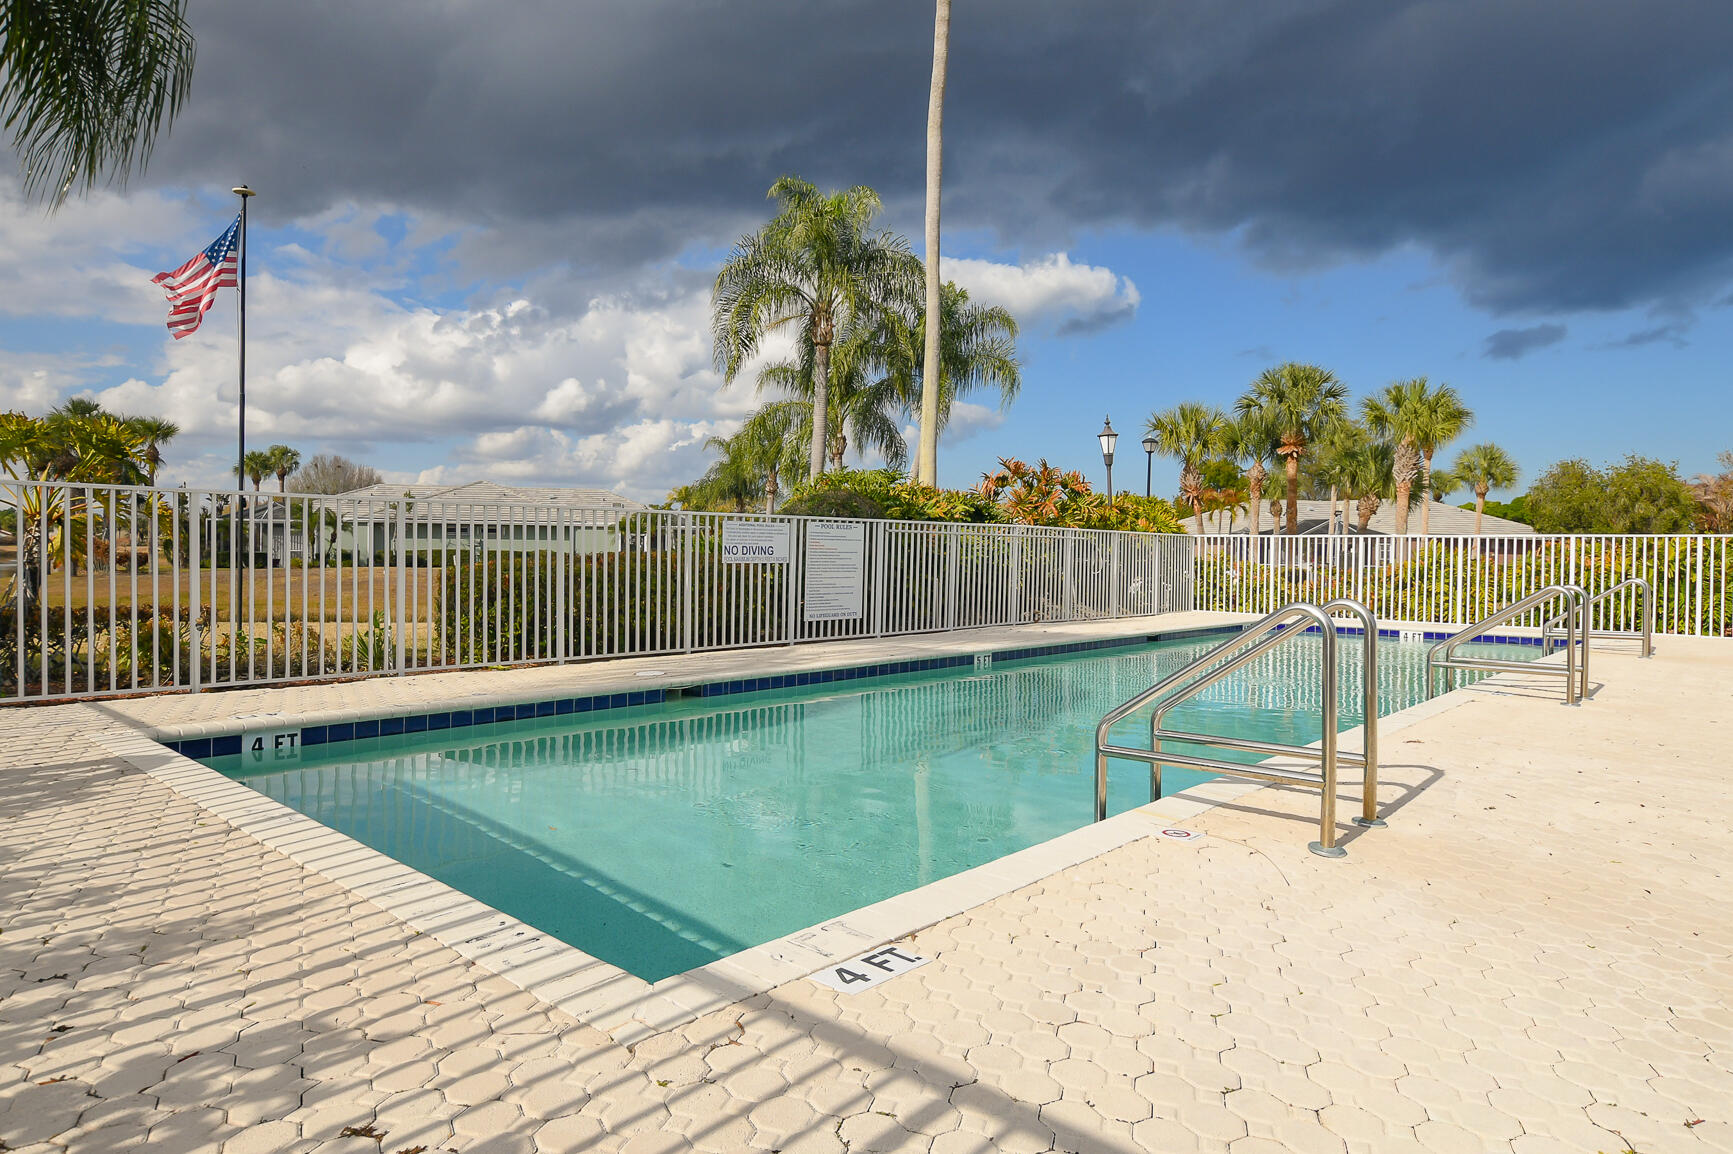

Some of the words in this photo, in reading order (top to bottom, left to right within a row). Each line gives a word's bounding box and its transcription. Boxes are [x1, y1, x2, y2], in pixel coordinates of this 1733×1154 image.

[724, 545, 739, 556] NO
[741, 545, 774, 556] DIVING
[1403, 632, 1409, 640] 4
[1412, 632, 1422, 641] FT
[976, 656, 982, 665] 5
[252, 737, 264, 751] 4
[275, 733, 298, 749] FT
[834, 966, 872, 985] 4
[860, 946, 923, 973] FT.
